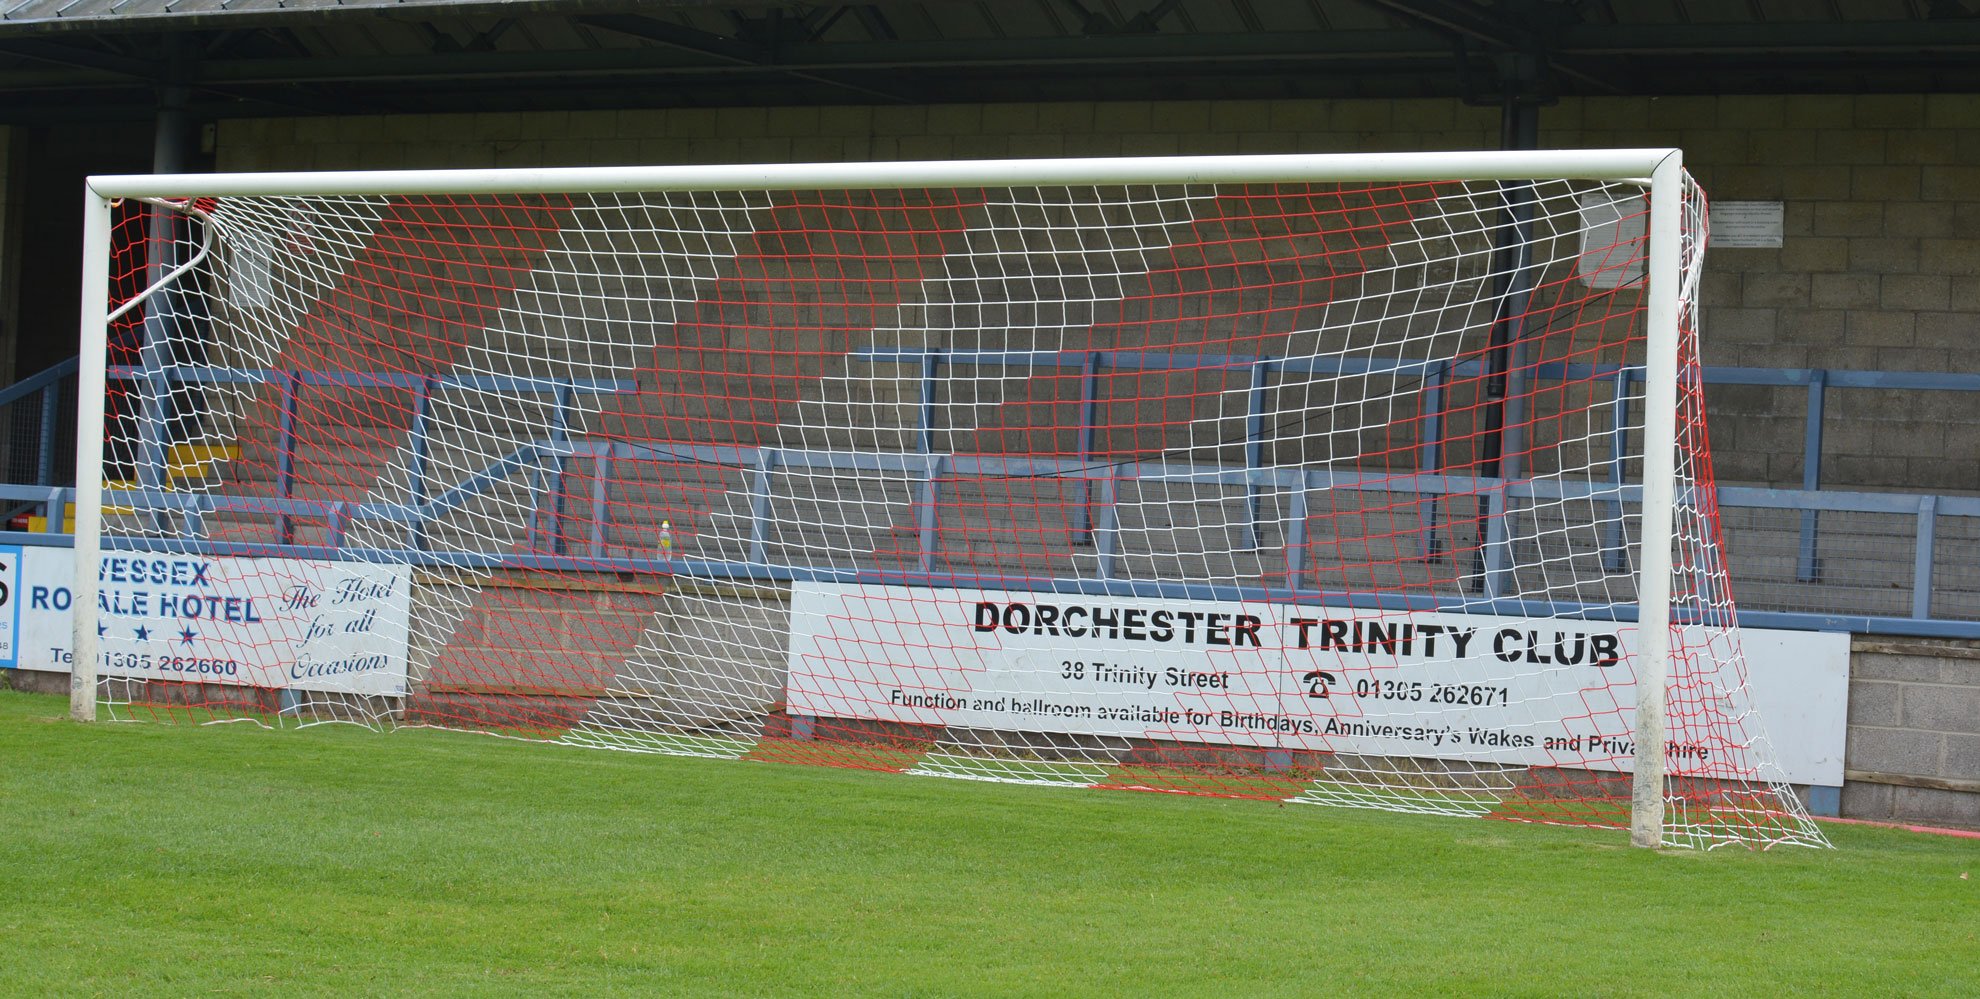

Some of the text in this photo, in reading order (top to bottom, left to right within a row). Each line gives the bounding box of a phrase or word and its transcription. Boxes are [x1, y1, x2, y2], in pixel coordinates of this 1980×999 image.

[31, 586, 260, 622] ROALE HOTEL
[279, 574, 398, 612] The Hotel
[296, 608, 377, 648] for all
[975, 602, 1618, 667] DORCHESTER TRINITY CLUB
[50, 647, 237, 676] Te 1305 262660
[291, 653, 387, 679] Occasions
[1061, 660, 1229, 689] 38 Trinity Street
[1357, 679, 1508, 707] 01305 262671
[891, 689, 967, 709] Function
[973, 697, 1005, 712] and
[1011, 699, 1091, 718] ballroom
[1097, 705, 1180, 724] available
[1186, 710, 1211, 726] for
[1220, 710, 1318, 736] Birthdays,
[1324, 717, 1461, 746] Anniversary's
[1468, 727, 1535, 748] Wakes
[1544, 734, 1581, 752] and
[1669, 740, 1708, 760] hire
